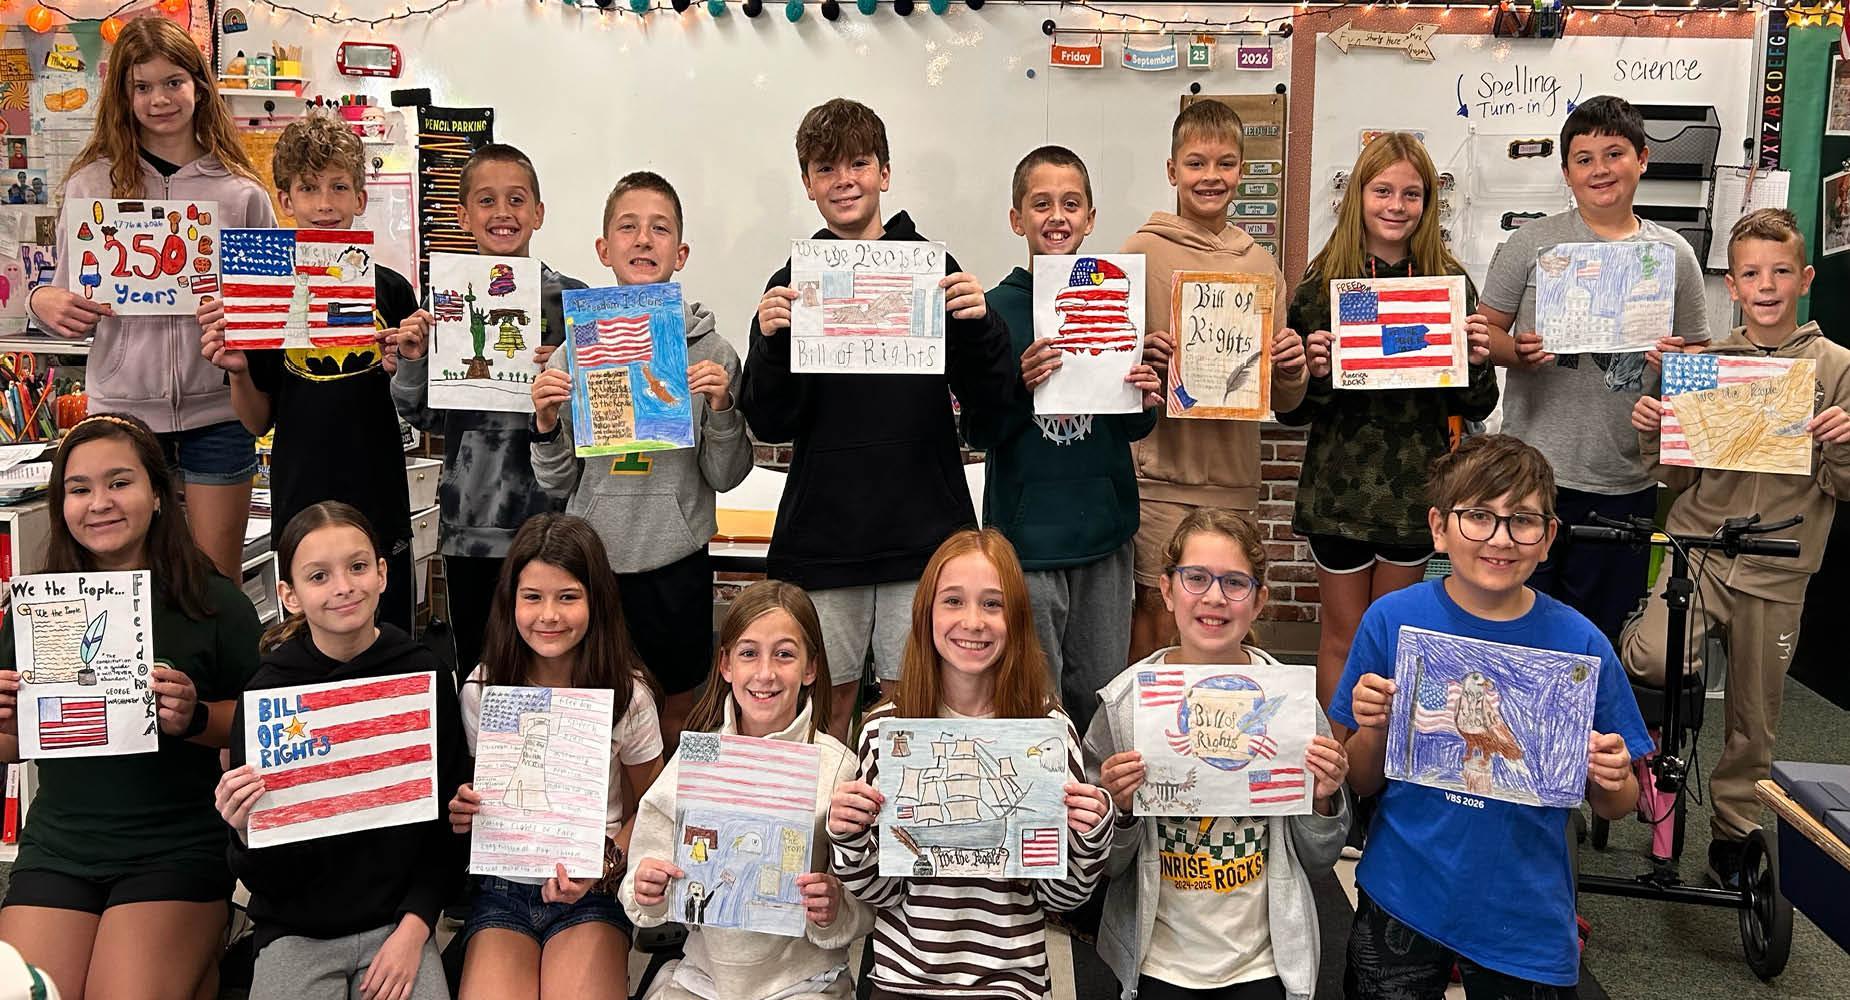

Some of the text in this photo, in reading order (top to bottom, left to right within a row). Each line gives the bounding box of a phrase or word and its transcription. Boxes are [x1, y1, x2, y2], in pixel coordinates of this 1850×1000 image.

[1386, 36, 1401, 45] Here
[1061, 51, 1091, 64] Friday
[1132, 54, 1175, 67] September
[1193, 51, 1206, 61] 25
[1241, 53, 1269, 65] 2026
[1478, 65, 1561, 116] Spelling
[1476, 100, 1541, 118] Turn-in
[425, 118, 487, 132] PENCIL PARKING
[1247, 225, 1263, 233] WIN
[104, 233, 187, 280] 250
[1193, 283, 1254, 313] Bill of
[1185, 315, 1254, 357] Rights
[796, 338, 937, 368] Bill of Rights
[11, 580, 36, 598] We
[45, 580, 67, 596] the
[34, 608, 49, 618] We
[51, 608, 63, 617] the
[105, 687, 131, 696] GEORGE
[258, 694, 311, 723] BILL
[1194, 703, 1239, 729] Bill of
[257, 723, 285, 749] OF
[1196, 730, 1241, 753] Rights
[260, 735, 332, 769] RIGHTS
[1444, 791, 1485, 809] VBS 2026
[938, 848, 1001, 869] We the People
[1213, 854, 1262, 890] ROCKS
[1174, 880, 1213, 890] 2024-2025
